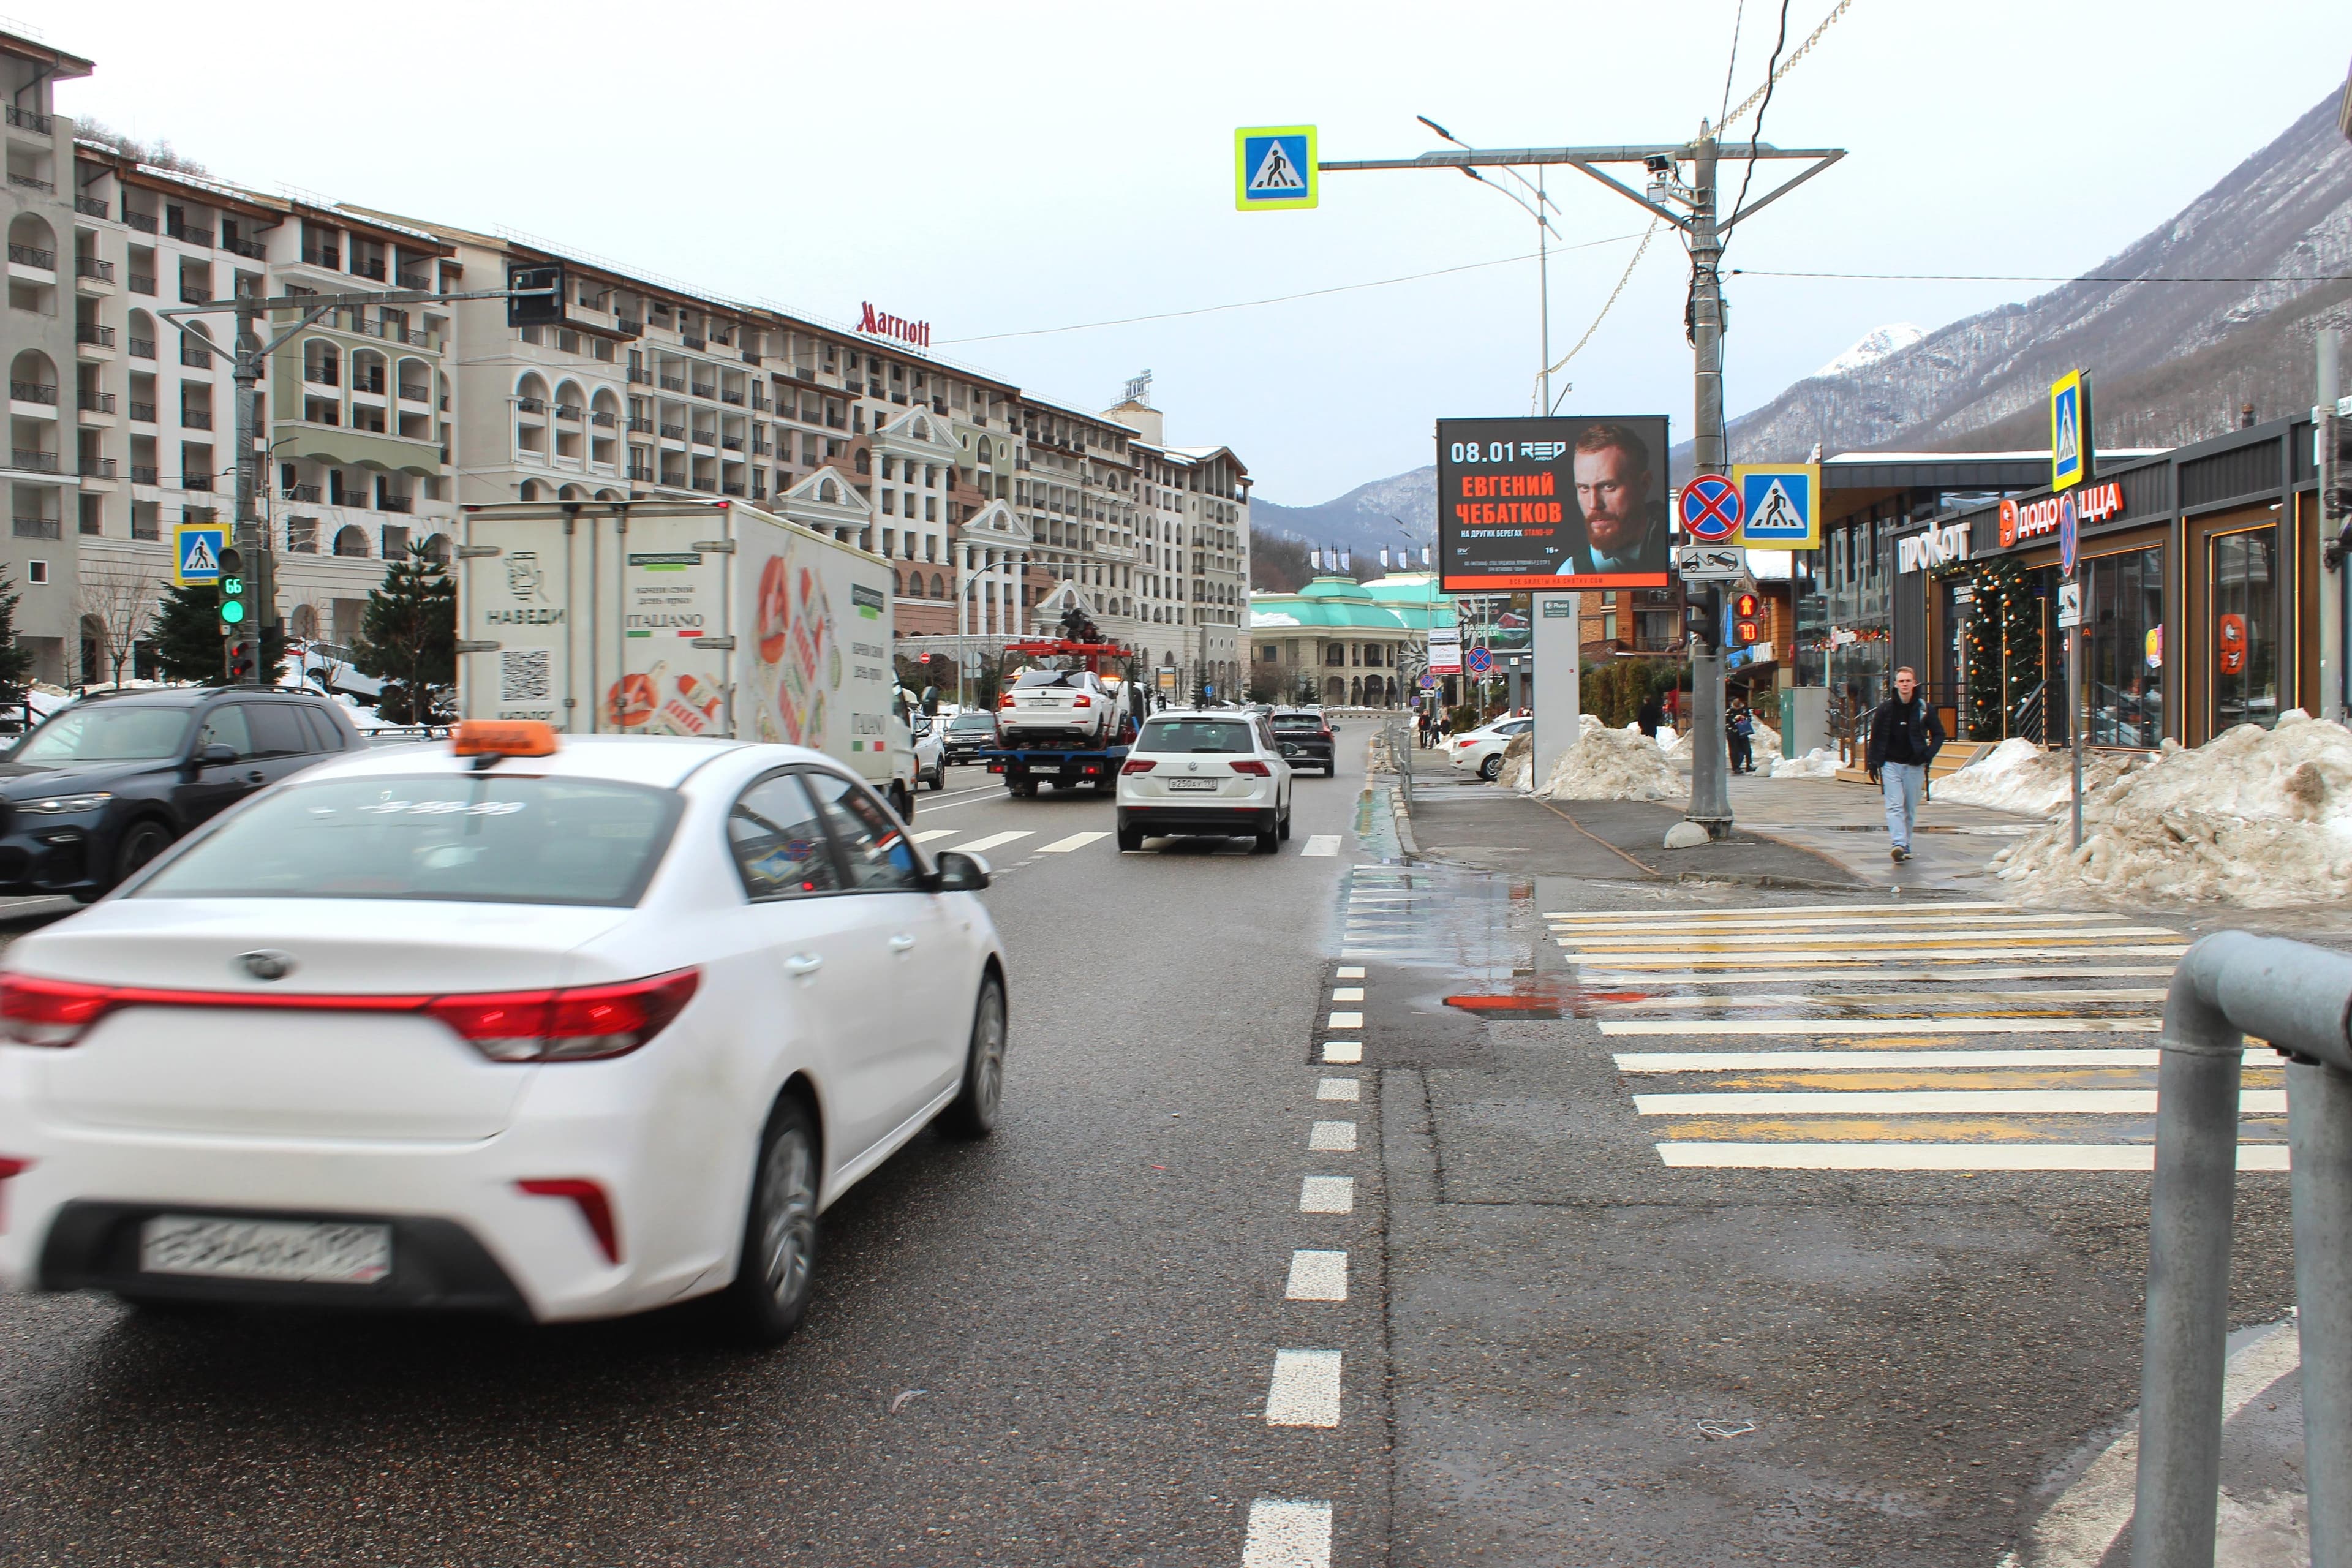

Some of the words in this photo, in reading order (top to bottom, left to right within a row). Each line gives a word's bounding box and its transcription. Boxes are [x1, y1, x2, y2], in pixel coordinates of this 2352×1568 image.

[856, 300, 930, 347] Marriott
[1451, 442, 1513, 463] 08.01
[1521, 442, 1566, 458] RED
[1462, 472, 1554, 497] ЕВГЕНИЙ
[1455, 502, 1562, 524] ЧЕБАТКОВ
[2060, 483, 2117, 522] ЦЦА
[225, 579, 242, 594] 66
[486, 609, 566, 625] НАВЕДИ
[625, 614, 704, 628] ITALIANO
[1740, 625, 1755, 639] 70
